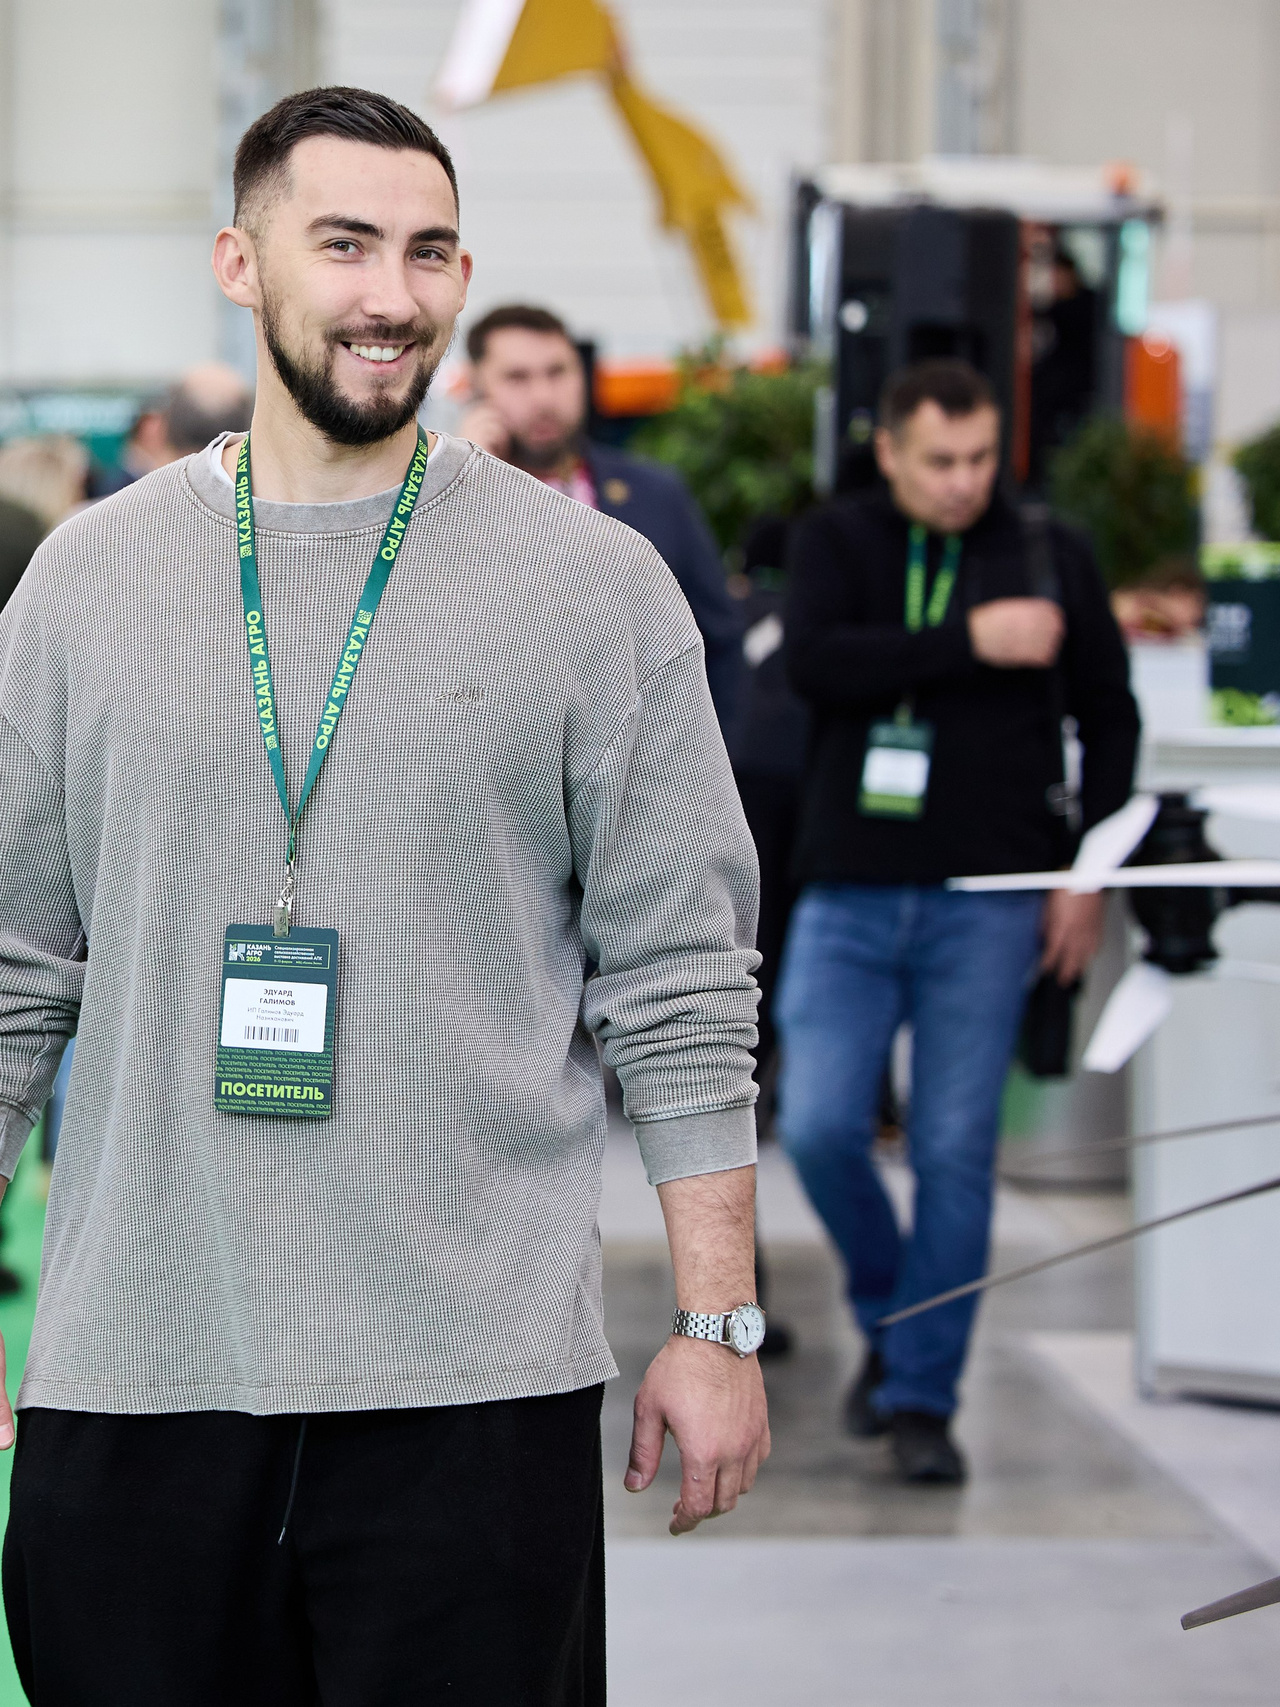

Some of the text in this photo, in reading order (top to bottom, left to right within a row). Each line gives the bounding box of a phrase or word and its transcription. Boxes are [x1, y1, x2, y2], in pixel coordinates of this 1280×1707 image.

[237, 476, 251, 543] КАЗАНЬ
[381, 451, 426, 560] КАЗАНЬ АГРО
[247, 611, 274, 734] КАЗАНЬ АГРО
[316, 625, 367, 749] КАЗАНЬ АГРО
[221, 1081, 324, 1100] ПОСЕТИТЕЛЬ
